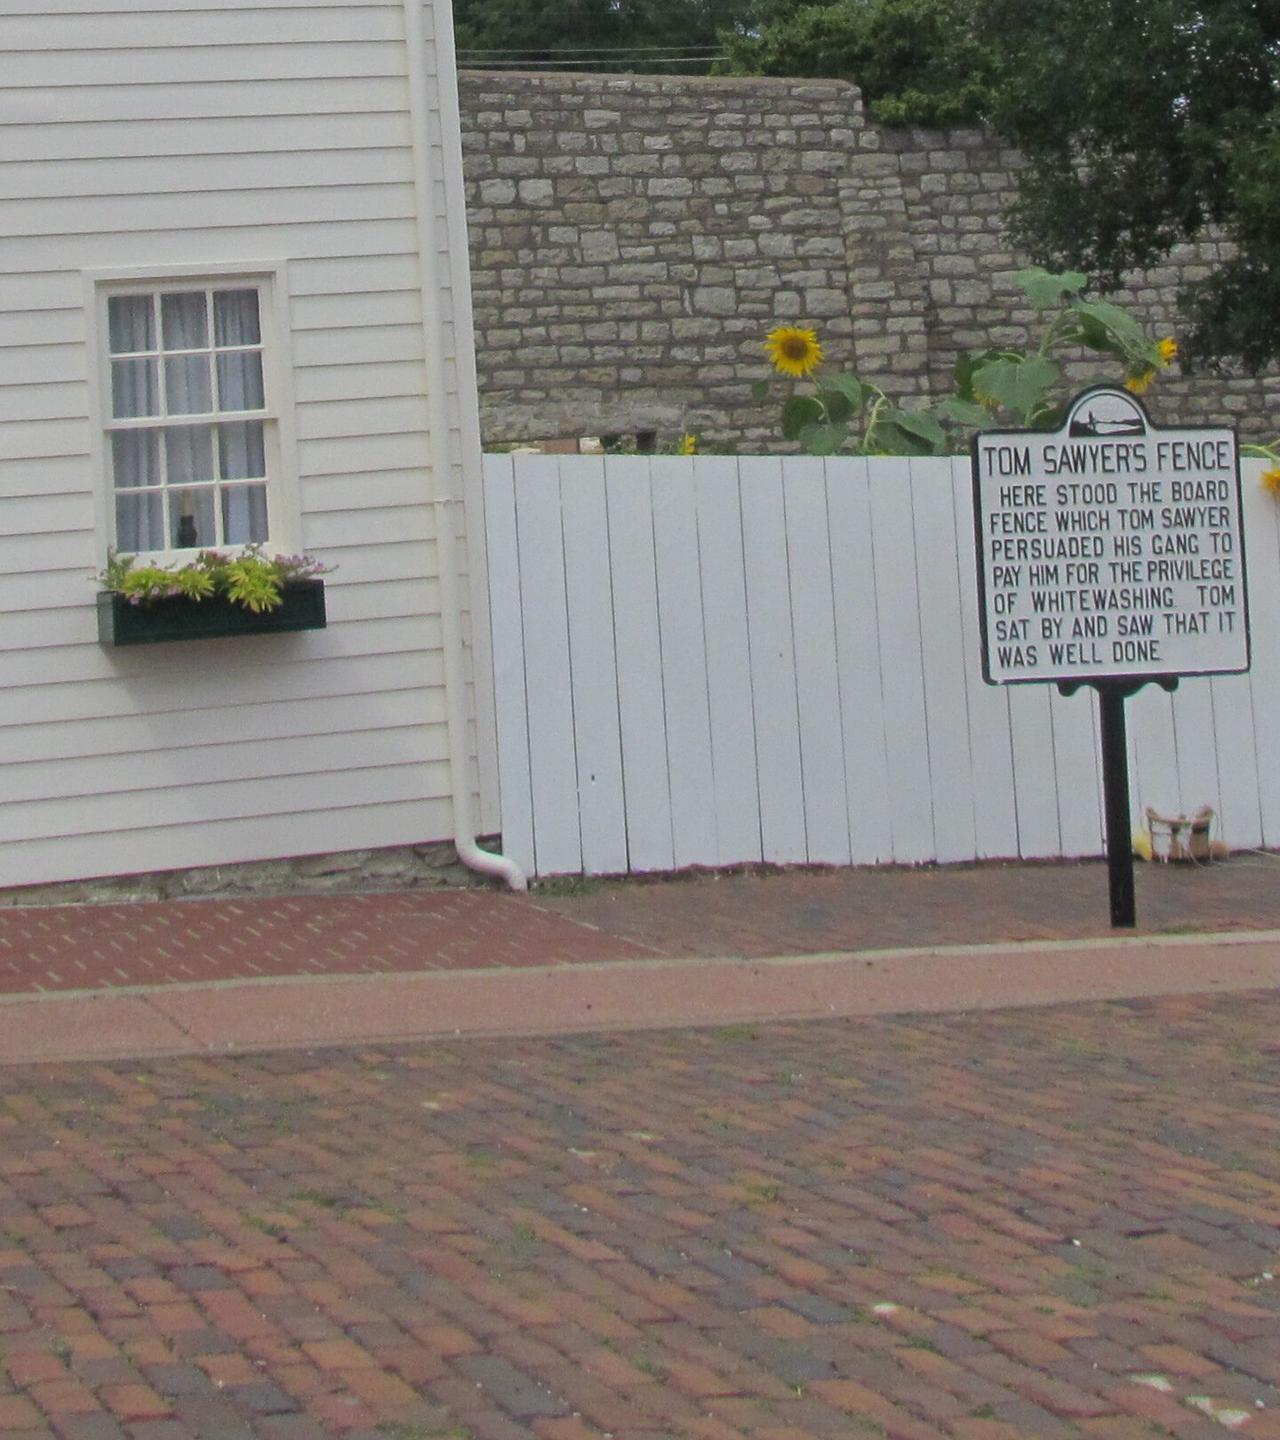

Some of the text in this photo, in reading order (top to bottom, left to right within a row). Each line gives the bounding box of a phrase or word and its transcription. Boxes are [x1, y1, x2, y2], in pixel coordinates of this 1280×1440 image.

[984, 441, 1230, 476] TOM SAWYER'S FENCE
[1000, 480, 1228, 507] HERE STOOD THE BOARD
[991, 507, 1229, 534] FENCE WHICH TOM SAWYER
[992, 533, 1232, 560] PERSUADED HIS GANG TO
[993, 559, 1233, 587] PAY HIM FOR THE PRIVILEGE
[994, 593, 1018, 614] OF
[1197, 585, 1235, 606] TOM
[996, 612, 1236, 641] SAT BY AND SAW THAT IT
[998, 646, 1037, 668] WAS
[1050, 643, 1103, 664] WELL
